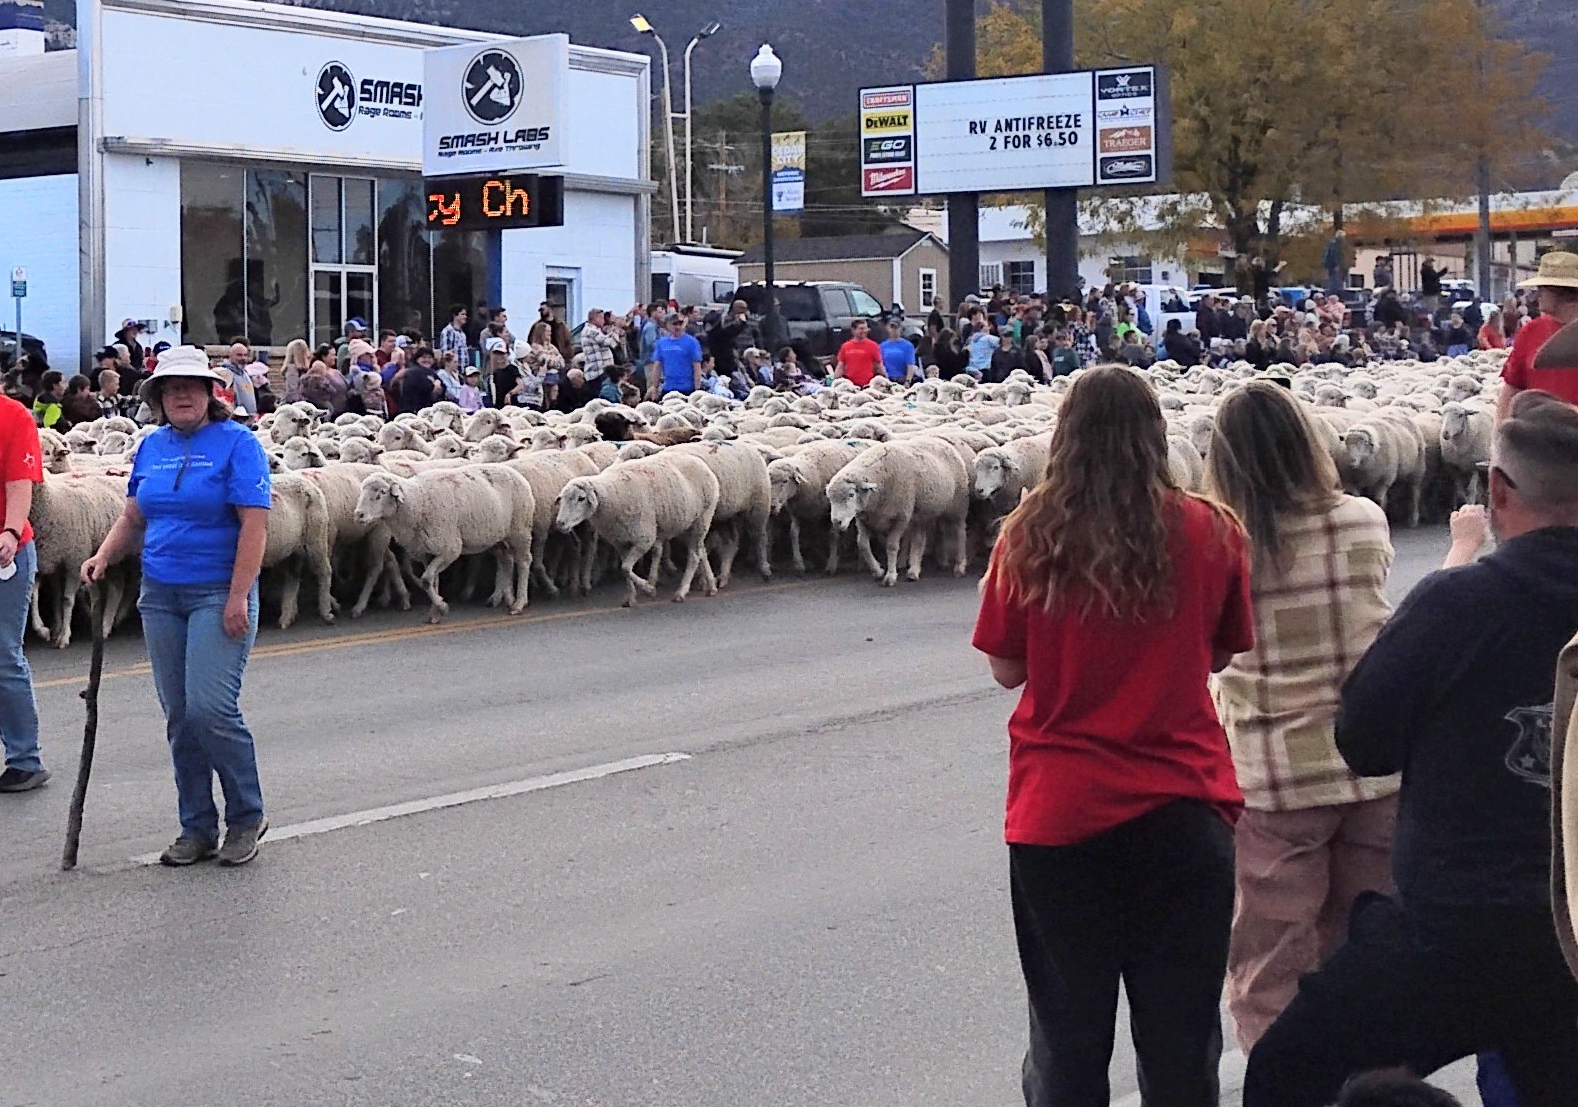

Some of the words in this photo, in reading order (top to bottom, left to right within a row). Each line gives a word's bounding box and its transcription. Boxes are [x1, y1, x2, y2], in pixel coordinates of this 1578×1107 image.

[1100, 85, 1148, 93] VORTEX
[358, 105, 381, 118] Rage
[969, 120, 987, 135] RV
[994, 114, 1082, 134] ANTIFREEZE
[439, 131, 499, 150] SMASH
[503, 126, 550, 143] LABS
[989, 136, 997, 150] 2
[1004, 134, 1031, 149] FOR
[1037, 131, 1078, 147] $6.50
[1103, 137, 1147, 149] TRAEGER
[482, 179, 529, 216] Ch
